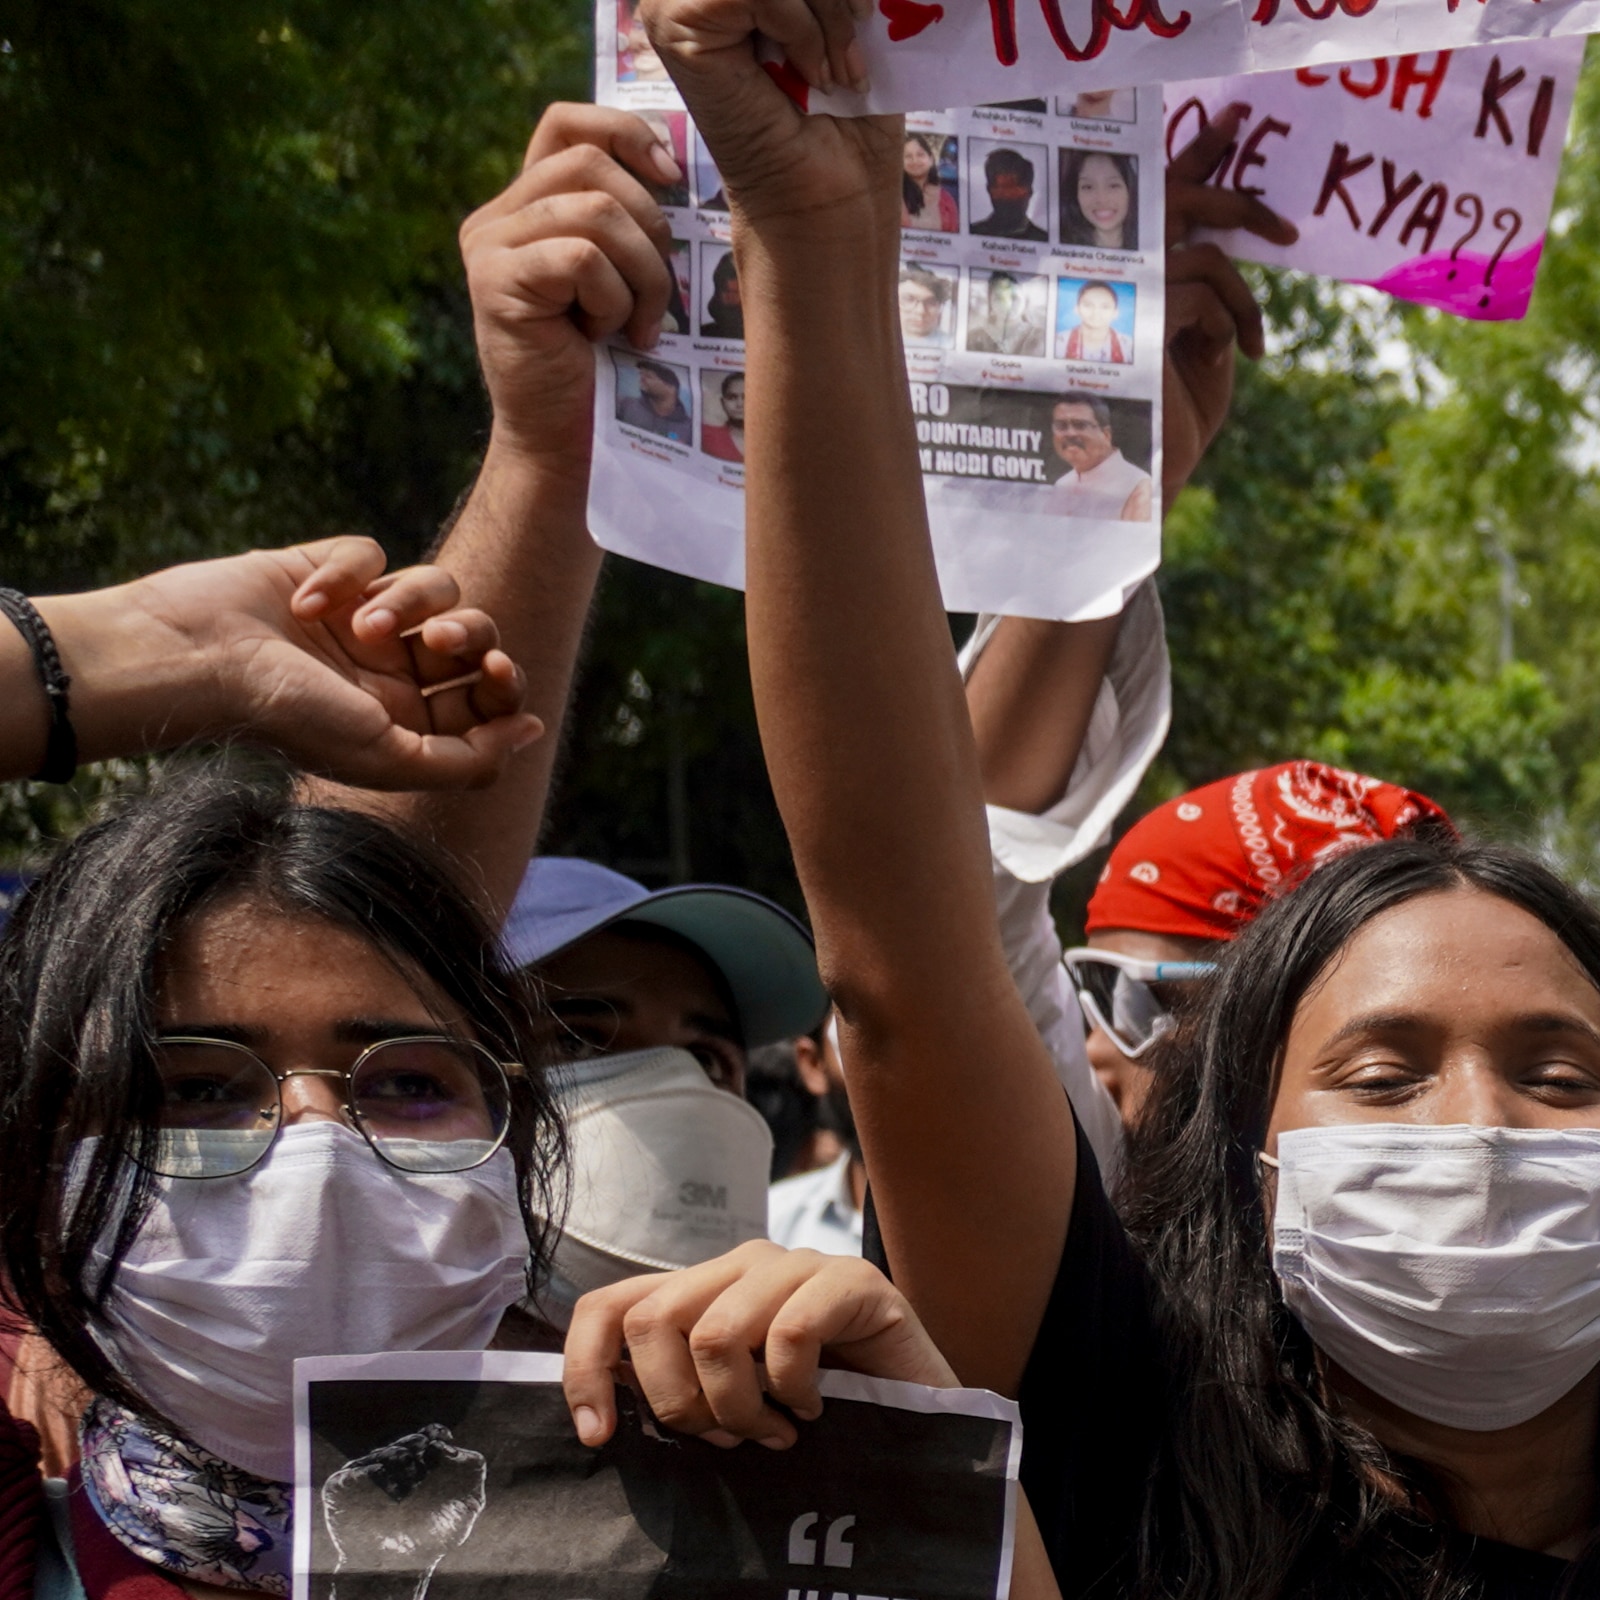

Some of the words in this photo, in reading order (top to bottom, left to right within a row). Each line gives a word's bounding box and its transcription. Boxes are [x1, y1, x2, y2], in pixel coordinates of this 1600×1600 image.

[1474, 54, 1556, 157] KI
[1313, 141, 1522, 308] KYA??
[910, 381, 950, 417] RO
[917, 420, 1043, 452] OUNTABILITY
[935, 450, 989, 474] MODI
[992, 455, 1047, 481] GOVT.
[678, 1180, 728, 1210] 3M
